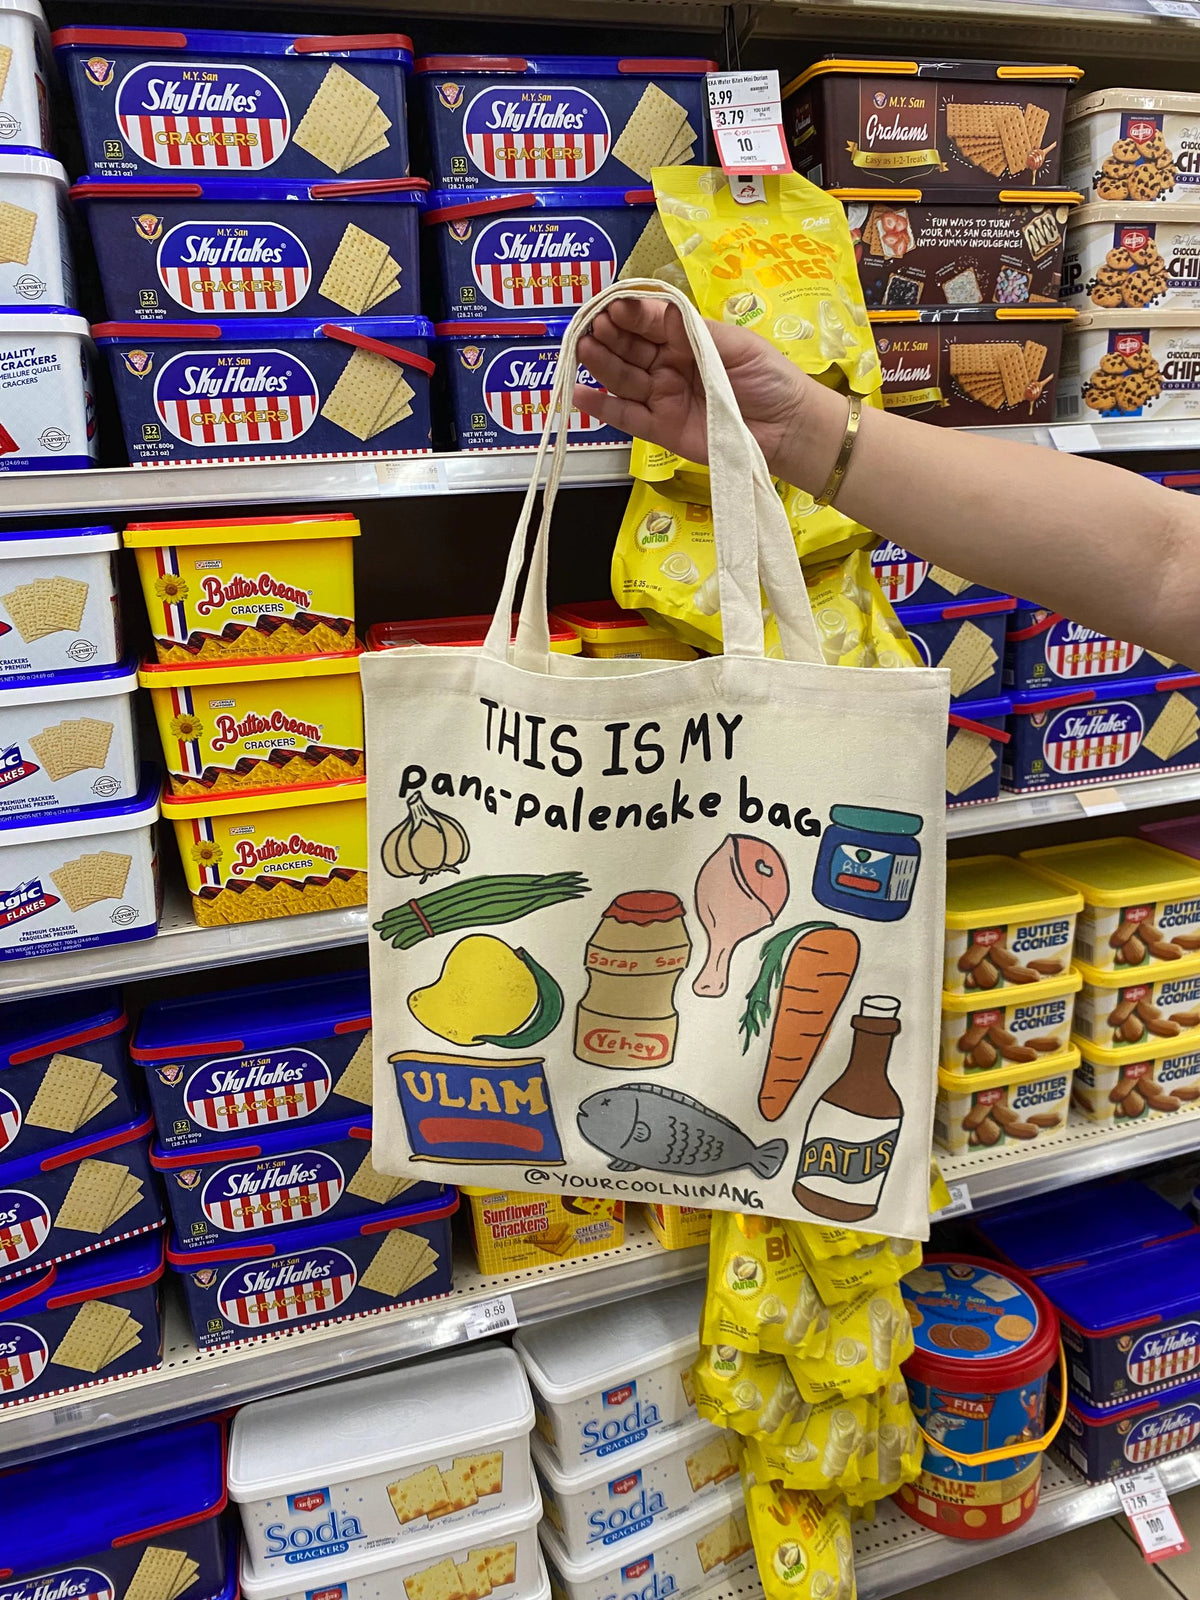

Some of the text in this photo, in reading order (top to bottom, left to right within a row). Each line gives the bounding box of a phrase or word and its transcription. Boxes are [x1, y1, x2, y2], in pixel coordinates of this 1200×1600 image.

[183, 71, 218, 81] M.Y. San
[521, 93, 552, 102] M.Y. San
[709, 90, 733, 106] 3.99
[889, 96, 925, 108] M.Y. San
[719, 109, 744, 125] 3.79
[866, 113, 928, 148] Grahams
[155, 131, 258, 147] CRACKERS
[737, 137, 753, 152] 10
[107, 142, 120, 152] 32
[495, 147, 583, 160] CRACKERS
[453, 159, 465, 167] 32
[865, 155, 880, 165] Easy
[529, 224, 559, 232] M.Y. San
[932, 217, 1011, 228] FUN WAYS TO TURN
[216, 228, 248, 236] M.Y. San
[920, 228, 1020, 238] YOUR M.Y. SAN GRAHAMS
[916, 238, 1023, 248] INTO YUMMY INDULGENCE!
[17, 283, 42, 291] EXPORT
[191, 280, 283, 293] CRACKERS
[503, 274, 589, 289] CRACKERS
[142, 291, 155, 300] 32
[463, 288, 473, 296] 32
[892, 341, 928, 352] M.Y. San
[1, 354, 57, 371] CRACKERS
[218, 357, 251, 366] M.Y. San
[2, 377, 38, 389] CRACKERS
[191, 409, 289, 426] CRACKERS
[145, 425, 158, 434] 32
[43, 436, 66, 444] EXPORT
[642, 534, 668, 545] durian
[231, 603, 284, 615] CRACKERS
[70, 646, 94, 655] EXPORT
[1065, 649, 1125, 663] CRACKERS
[5, 663, 32, 671] PREMIUM
[244, 738, 296, 750] CRACKERS
[480, 697, 743, 777] THIS IS MY
[95, 783, 118, 791] EXPORT
[27, 795, 56, 803] CRACKERS
[33, 799, 59, 808] PREMIUM
[263, 859, 313, 873] CRACKERS
[842, 860, 877, 877] Biks
[6, 899, 46, 921] FLAKES
[114, 911, 135, 919] EXPORT
[19, 929, 78, 942] CRAQUELINS PREMIUM
[22, 928, 47, 936] PREMIUM
[1017, 921, 1069, 940] BUTTER
[1012, 933, 1068, 953] COOKIES
[588, 953, 685, 971] Sarap Sar
[1014, 1000, 1066, 1020] BUTTER
[1010, 1012, 1065, 1033] COOKIES
[597, 1033, 655, 1057] Yehey
[240, 1060, 256, 1068] M.Y.
[402, 1071, 548, 1115] ULAM
[1017, 1076, 1066, 1097] BUTTER
[216, 1093, 304, 1116] CRACKERS
[1012, 1088, 1066, 1110] COOKIES
[803, 1139, 893, 1175] PATIS
[256, 1163, 271, 1171] M.Y.
[524, 1169, 763, 1209] @YOURCOOLNINANG
[233, 1193, 319, 1217] CRACKERS
[483, 1201, 547, 1225] Sunflower
[491, 1217, 549, 1239] Crackers
[576, 1220, 611, 1234] CHEESE
[271, 1261, 286, 1269] M.Y.
[732, 1279, 758, 1290] durian
[248, 1288, 331, 1314] CRACKERS
[484, 1304, 506, 1318] 8.59
[954, 1399, 985, 1413] FITA
[582, 1401, 660, 1448] Soda
[599, 1431, 646, 1455] CRACKERS
[588, 1490, 665, 1537] Soda
[264, 1511, 362, 1553] Soda
[605, 1519, 652, 1543] CRACKERS
[1146, 1517, 1164, 1534] 100
[288, 1543, 346, 1562] CRACKERS
[783, 1562, 806, 1580] durian
